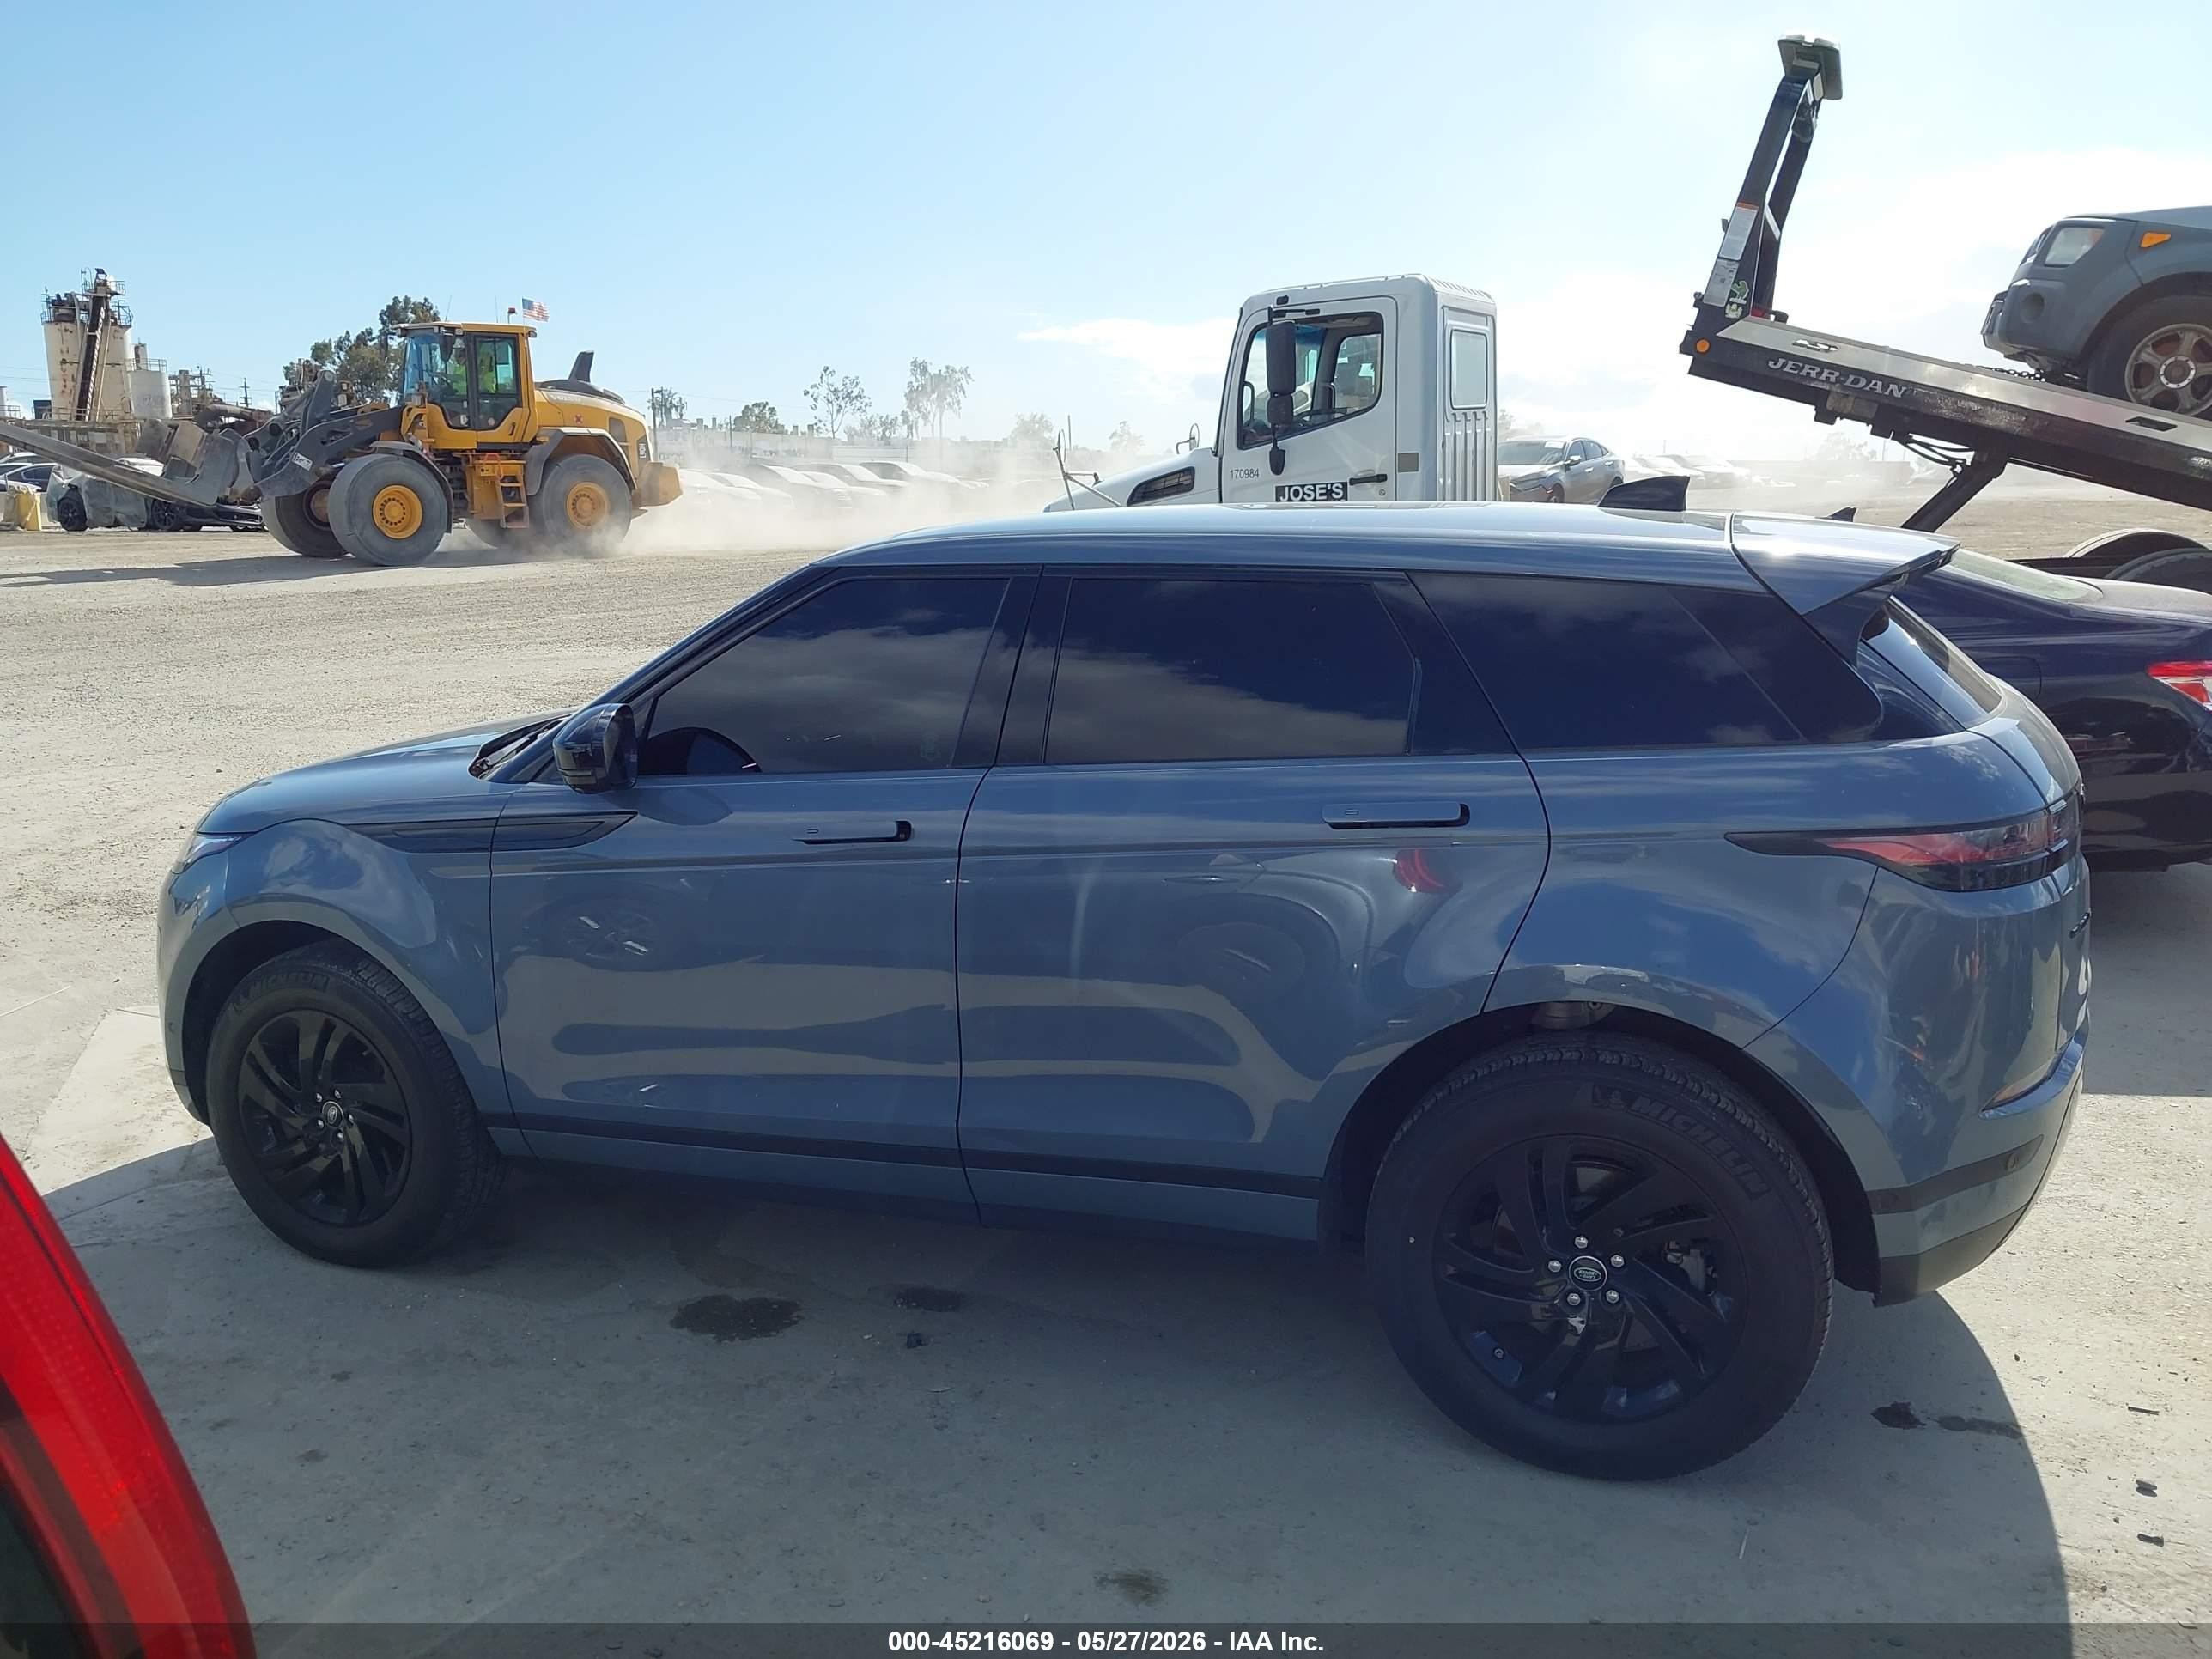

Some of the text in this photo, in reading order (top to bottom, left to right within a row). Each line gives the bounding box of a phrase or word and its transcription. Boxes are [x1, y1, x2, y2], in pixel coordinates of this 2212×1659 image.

[1768, 358, 1906, 398] JERR-DAN
[1230, 468, 1260, 479] 170984
[1279, 483, 1344, 501] JOSE'S
[1631, 1093, 1770, 1200] MICHELIN
